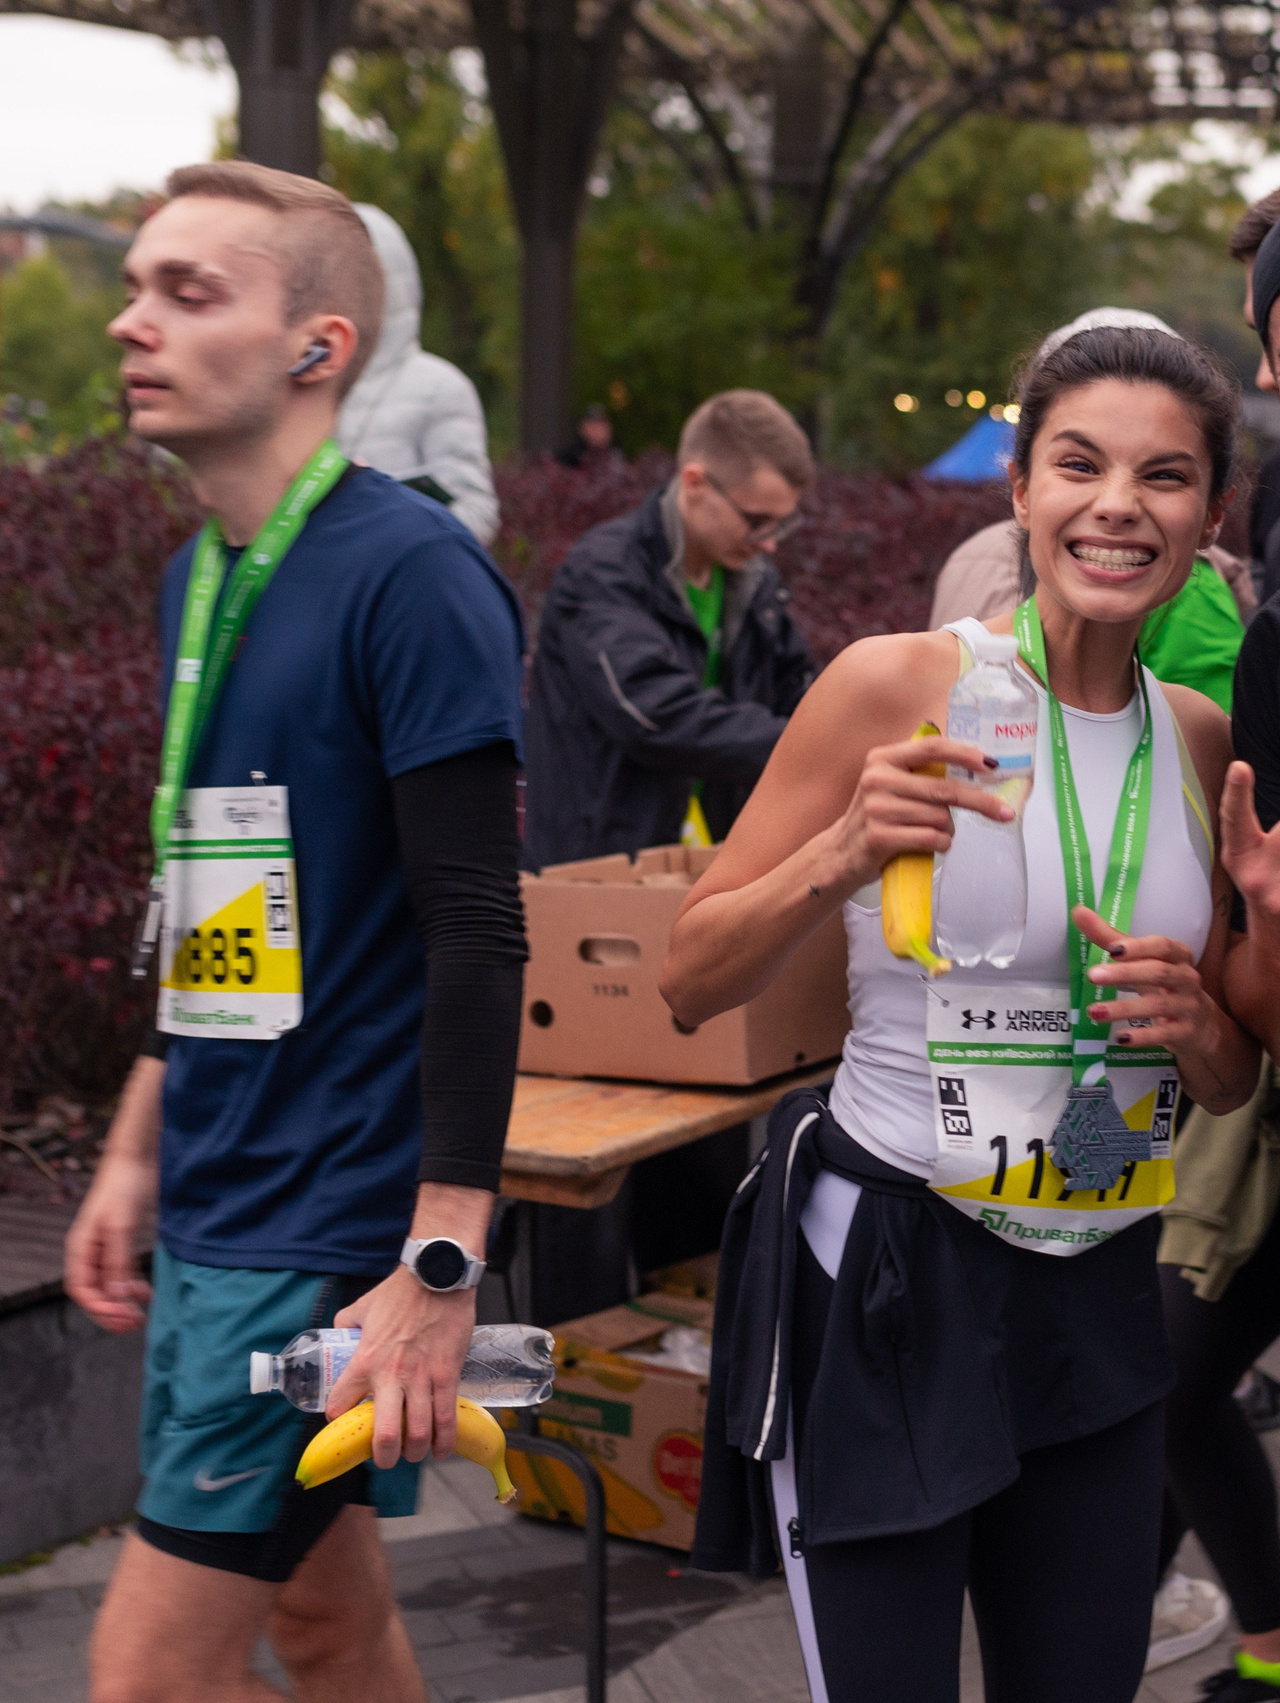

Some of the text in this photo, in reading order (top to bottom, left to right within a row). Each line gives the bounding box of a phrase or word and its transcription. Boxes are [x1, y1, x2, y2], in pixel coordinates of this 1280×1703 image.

[593, 983, 630, 998] 1134
[1006, 1008, 1069, 1022] UNDER
[1005, 1020, 1072, 1033] ARMOU
